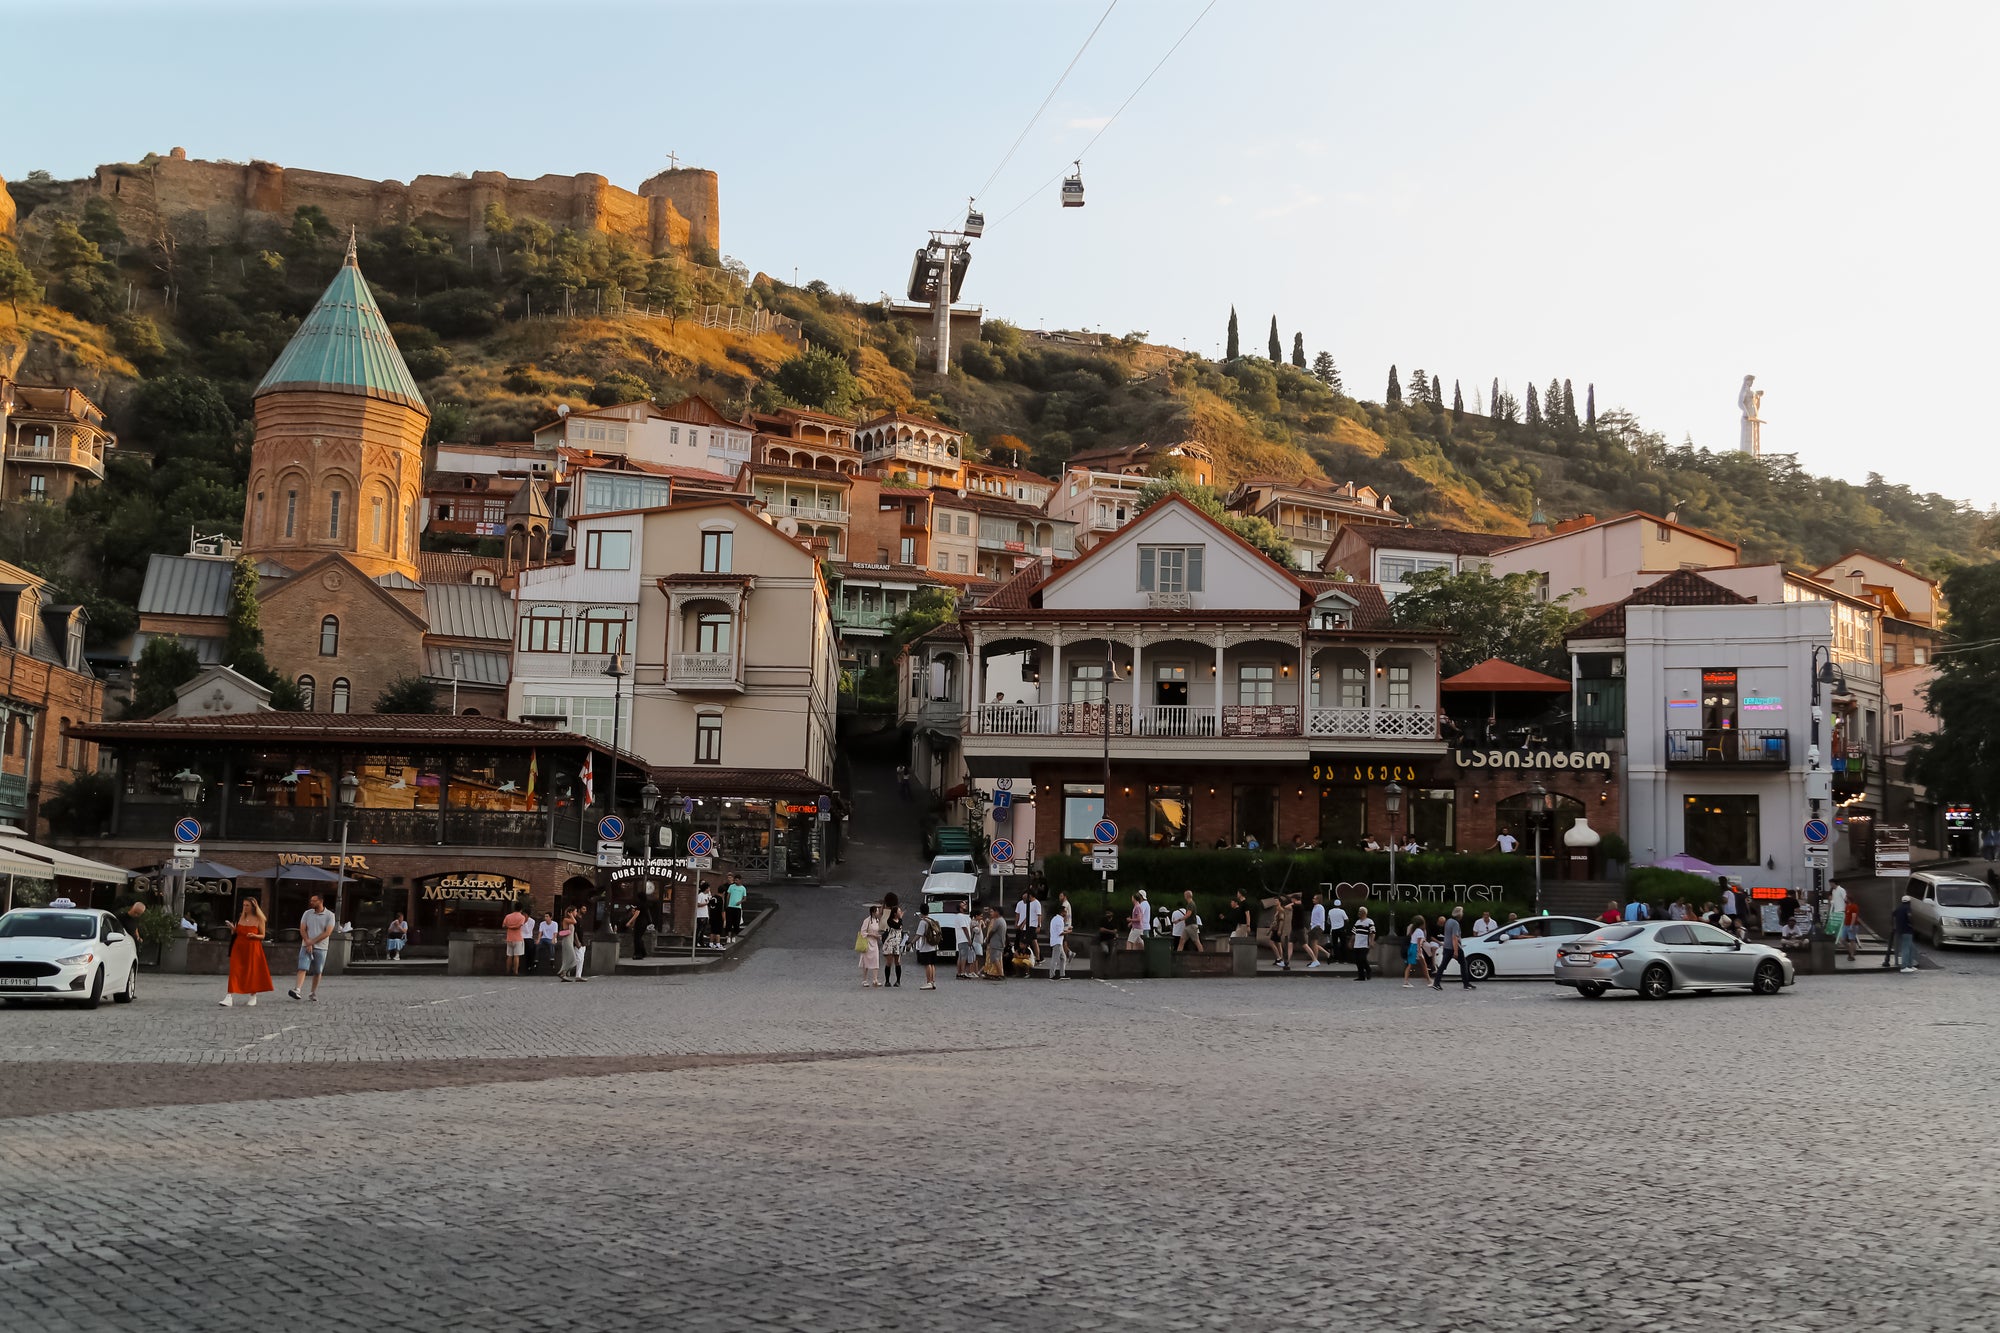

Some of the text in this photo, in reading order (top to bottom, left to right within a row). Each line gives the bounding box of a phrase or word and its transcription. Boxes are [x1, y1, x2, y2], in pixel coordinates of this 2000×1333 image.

[853, 562, 890, 570] RESTAURANT
[1455, 750, 1611, 769] სამიკიტნო
[278, 853, 370, 869] WINE BAR
[440, 877, 501, 888] CHÂTEAU
[422, 885, 521, 902] MUKHRANI
